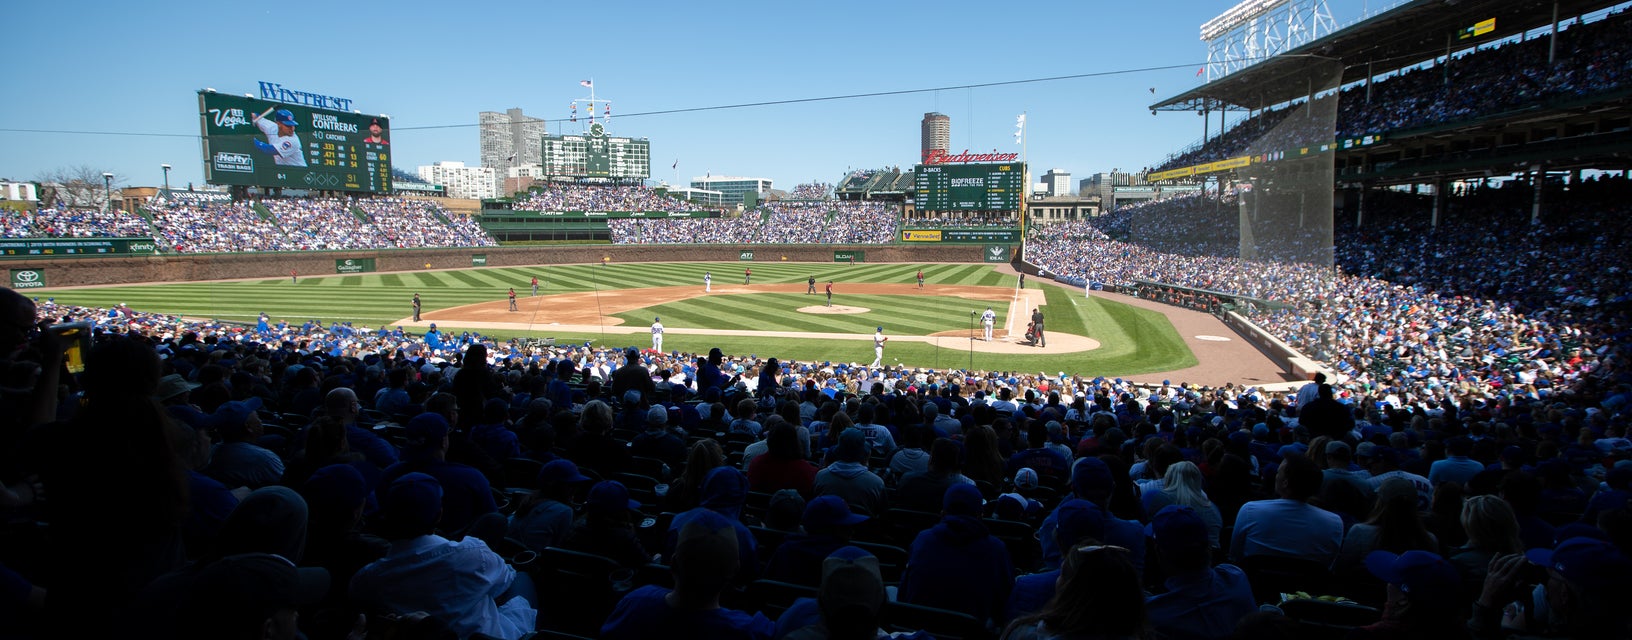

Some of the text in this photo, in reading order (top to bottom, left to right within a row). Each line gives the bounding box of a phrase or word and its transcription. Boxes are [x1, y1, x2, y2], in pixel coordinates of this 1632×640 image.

[258, 81, 352, 111] WINTRUST
[208, 108, 250, 129] Vegas
[312, 113, 337, 121] WILLSON
[312, 120, 358, 133] CONTRERAS
[312, 130, 324, 139] 40
[219, 154, 248, 164] Hefty
[924, 148, 1018, 165] Budweiser
[129, 243, 155, 251] xfinity
